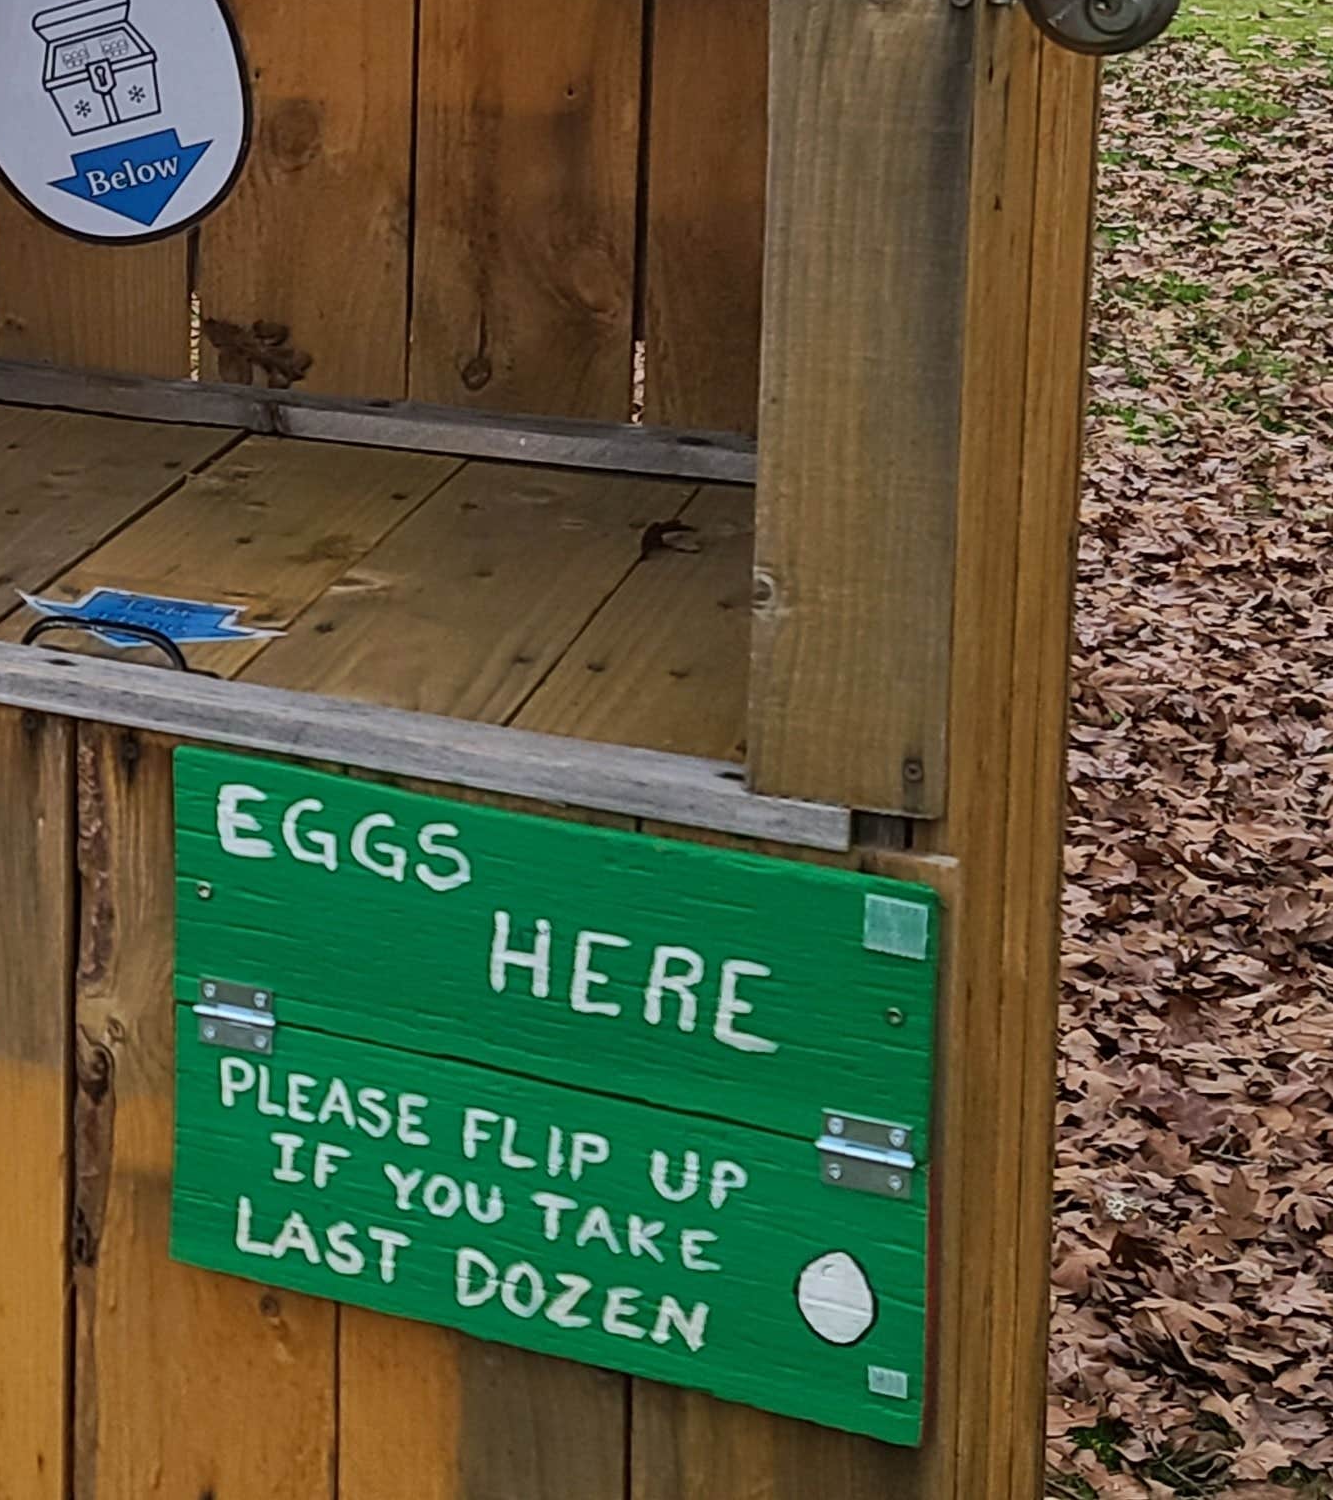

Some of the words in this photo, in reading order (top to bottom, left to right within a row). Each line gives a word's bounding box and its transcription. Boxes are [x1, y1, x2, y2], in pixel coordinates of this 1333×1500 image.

[85, 153, 180, 198] Below
[215, 782, 473, 892] EGGS
[489, 910, 779, 1054] HERE
[219, 1056, 432, 1146] PLEASE
[462, 1106, 611, 1181] FLIP
[649, 1149, 748, 1209] UP
[269, 1131, 351, 1190] IF
[384, 1160, 506, 1224] YOU
[531, 1192, 722, 1272] TAKE
[235, 1196, 412, 1283] LAST
[454, 1247, 710, 1352] DOZEN
